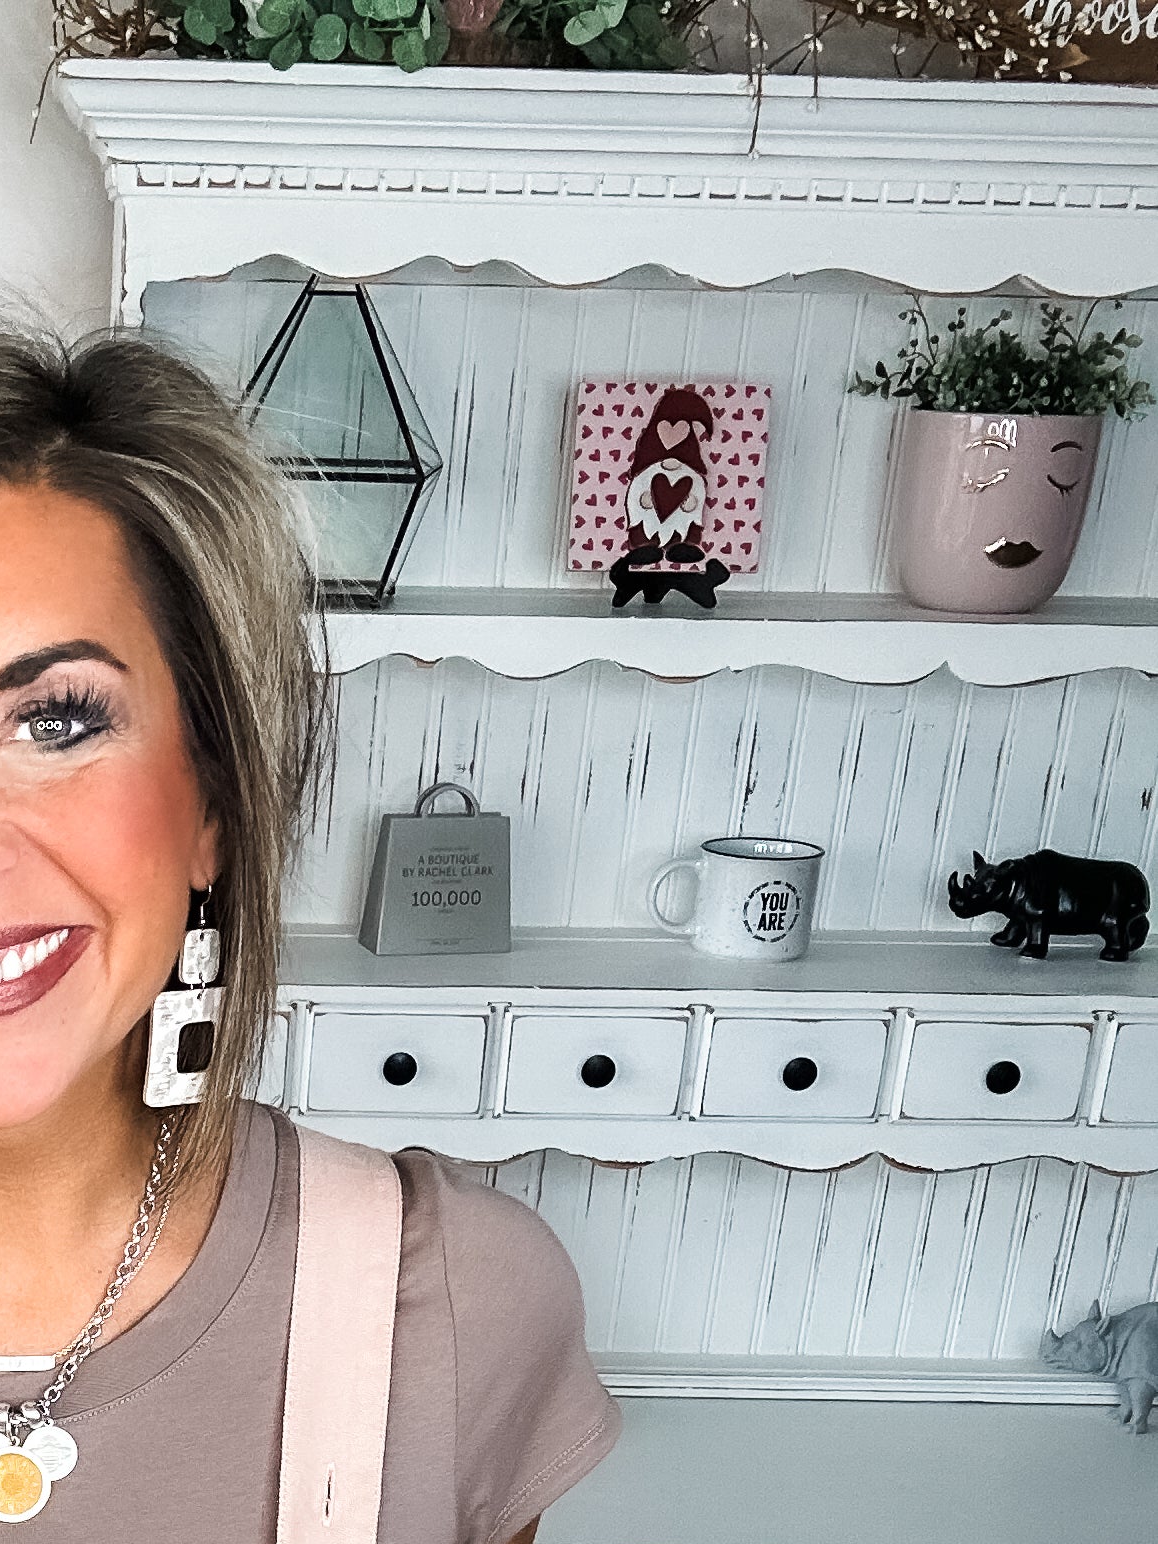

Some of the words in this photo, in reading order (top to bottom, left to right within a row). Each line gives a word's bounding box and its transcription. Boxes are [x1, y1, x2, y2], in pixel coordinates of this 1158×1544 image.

[418, 855, 425, 865] A
[428, 854, 480, 865] BOUTIQUE
[402, 867, 415, 878] BY
[418, 867, 458, 877] RACHEL
[461, 865, 494, 877] CLARK
[411, 890, 482, 908] 100,000
[761, 892, 789, 912] YOU
[757, 912, 786, 931] ARE
